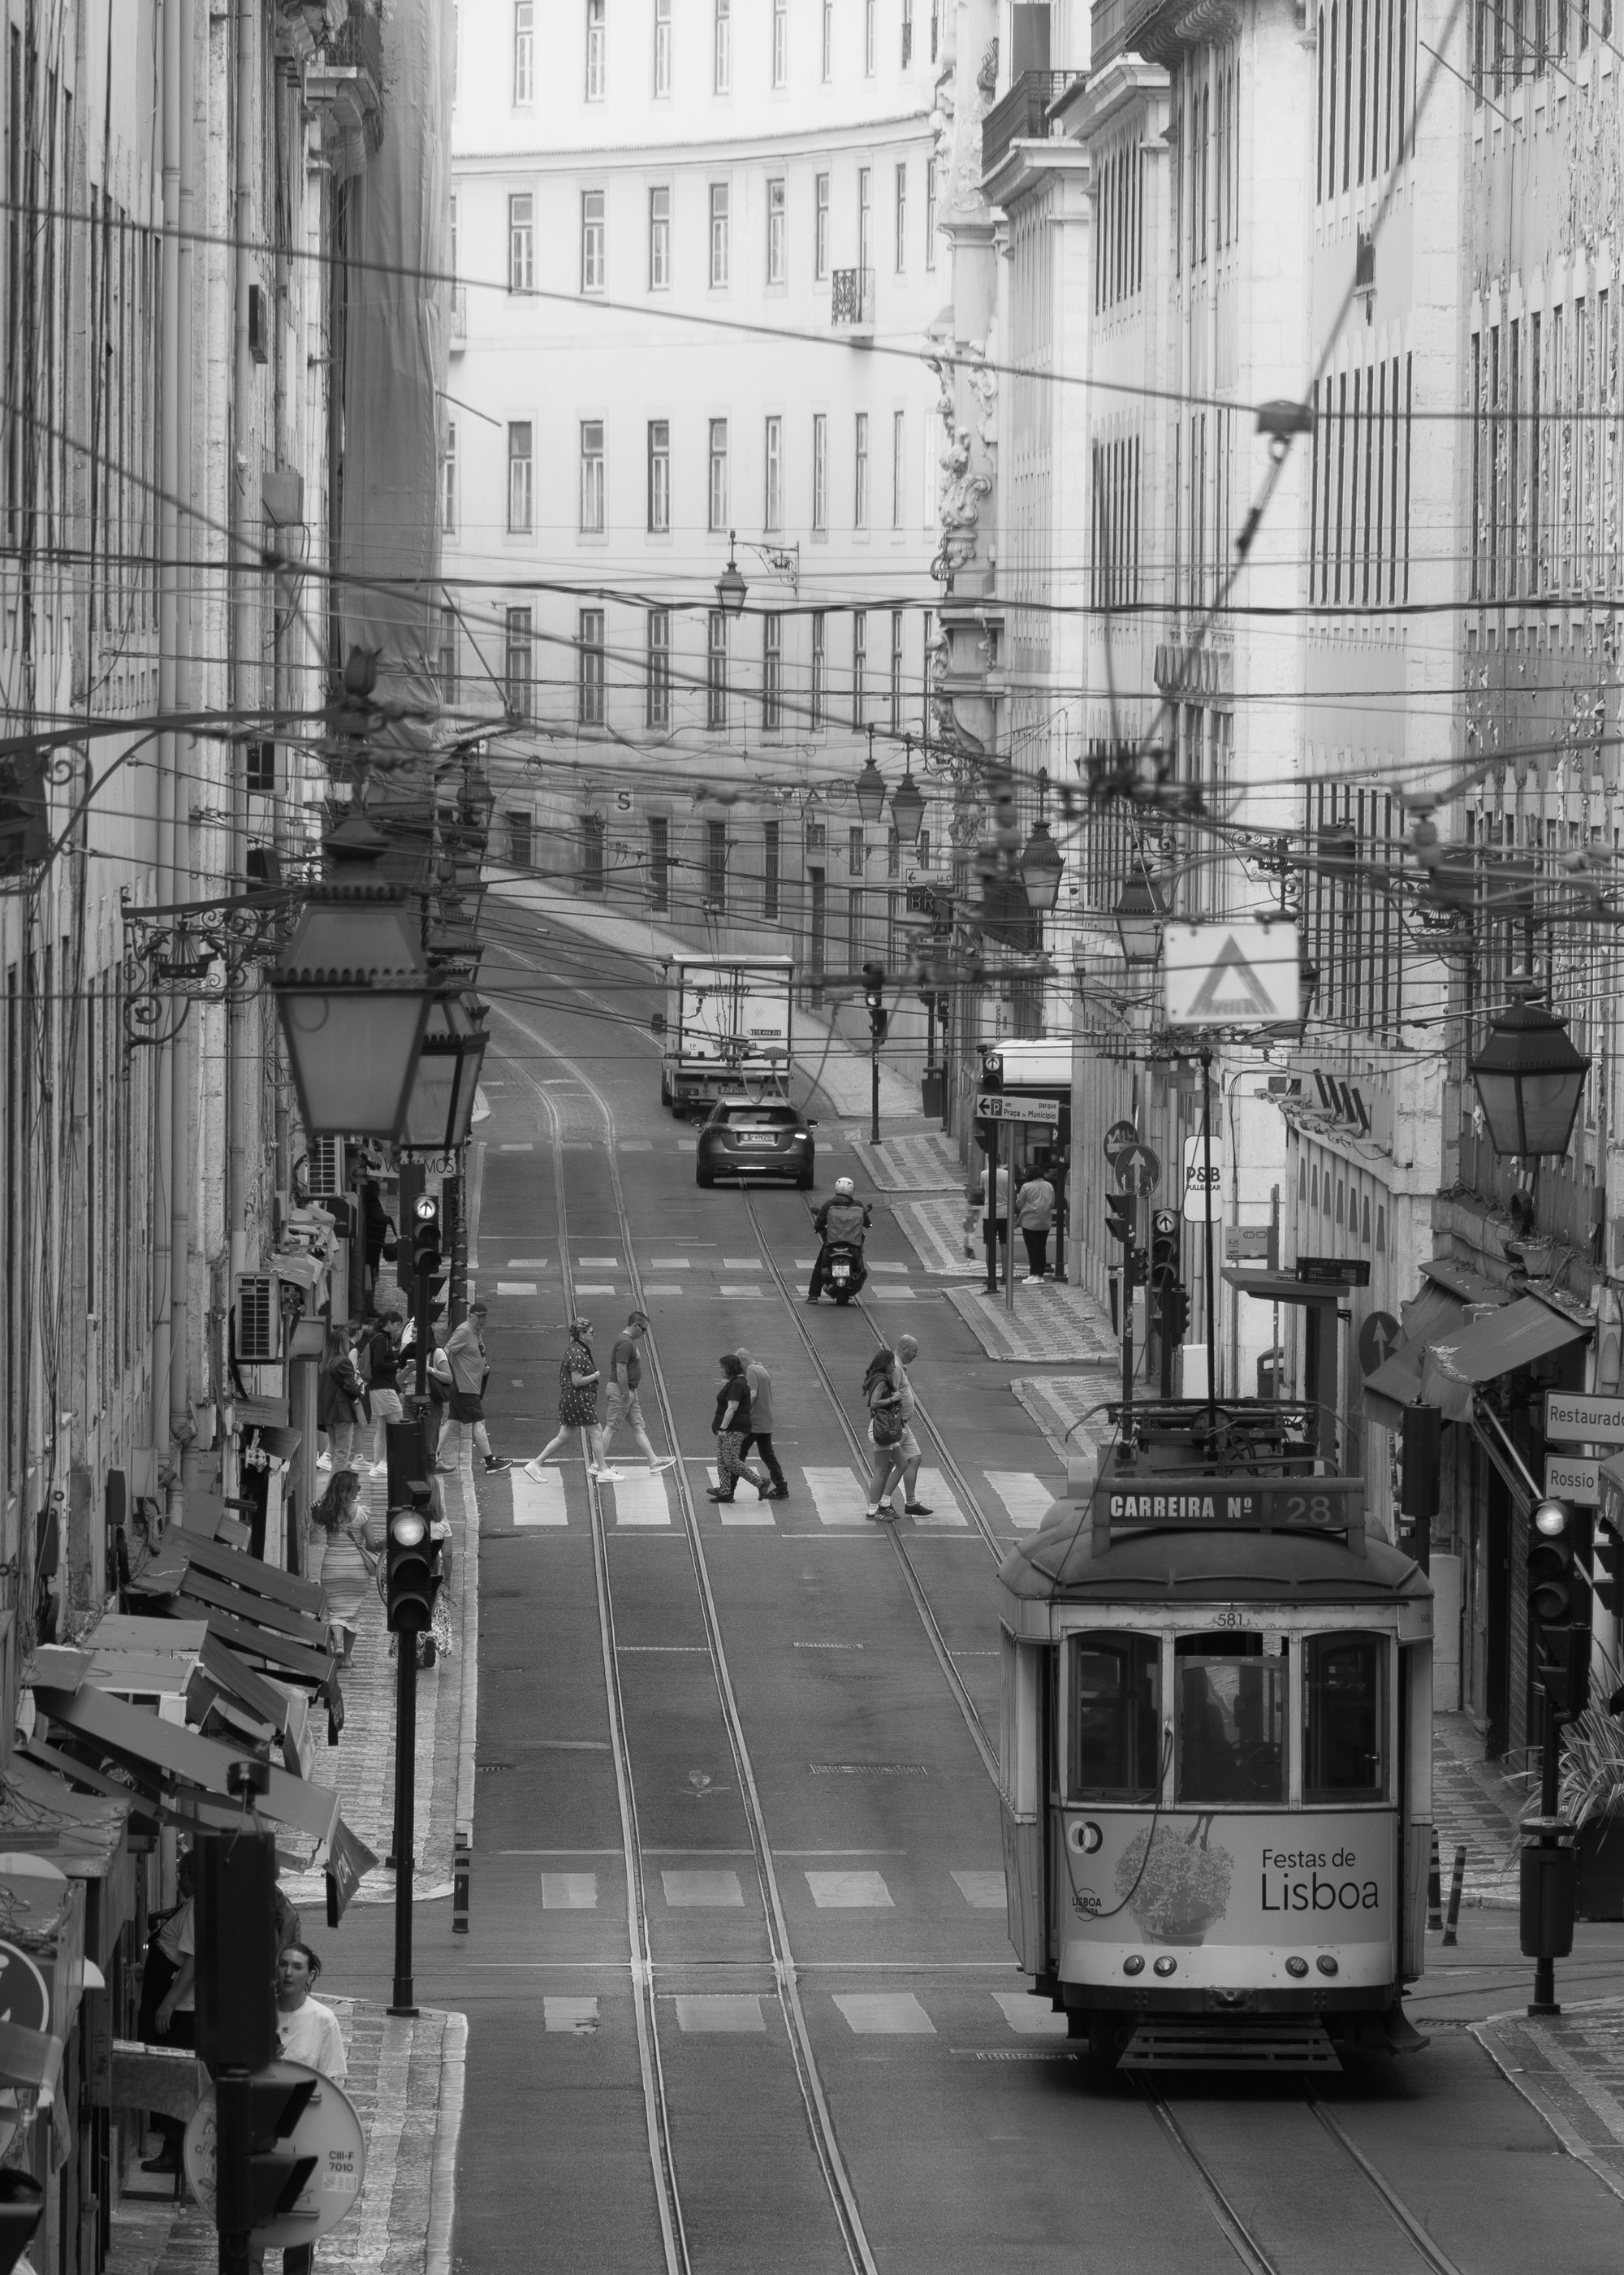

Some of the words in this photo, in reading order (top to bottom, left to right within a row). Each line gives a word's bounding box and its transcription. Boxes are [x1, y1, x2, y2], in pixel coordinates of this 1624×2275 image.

[1004, 1108, 1020, 1118] Praça
[1186, 1166, 1220, 1183] P&B
[1550, 1469, 1595, 1488] Rossio
[1110, 1495, 1215, 1518] CARREIRA
[1227, 1496, 1252, 1518] Nº
[1286, 1495, 1332, 1524] 28
[1216, 1612, 1243, 1627] 581
[1263, 1849, 1326, 1868] Festas
[1332, 1847, 1356, 1867] de
[1262, 1871, 1379, 1911] Lisboa
[1072, 1897, 1102, 1907] LISBOA
[328, 2150, 355, 2160] CIII-F
[329, 2161, 354, 2172] 7010
